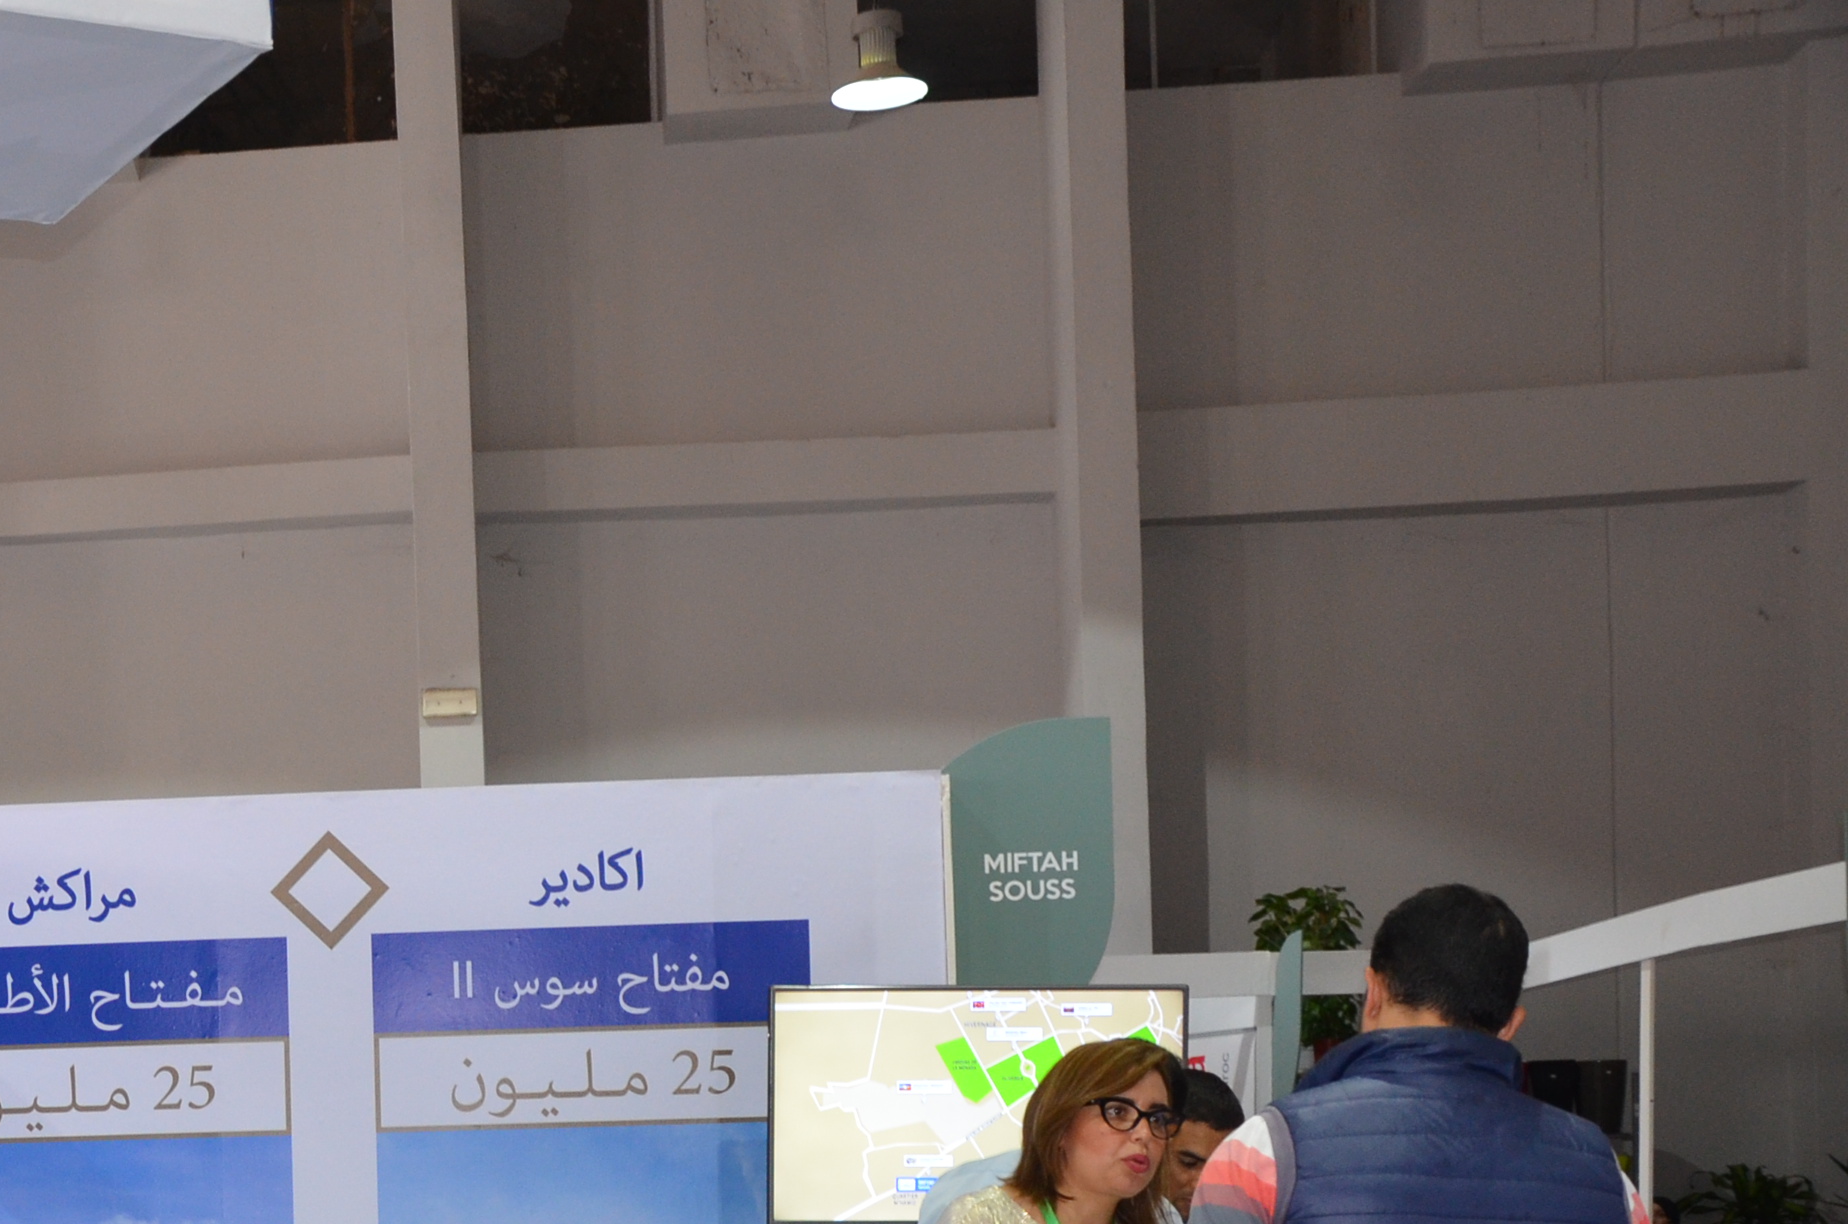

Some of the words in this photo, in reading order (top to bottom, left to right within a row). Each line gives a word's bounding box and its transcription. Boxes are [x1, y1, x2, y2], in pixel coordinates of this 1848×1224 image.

[528, 848, 646, 908] اكادير
[983, 850, 1079, 875] MIFTAH
[7, 867, 137, 926] مراكش
[988, 878, 1077, 903] SOUSS
[89, 967, 244, 1032] مفتاح
[494, 972, 599, 1011] سوس
[616, 952, 731, 1015] مفتاح
[152, 1064, 217, 1112] 25
[450, 1048, 649, 1118] مليون
[671, 1048, 737, 1096] 25
